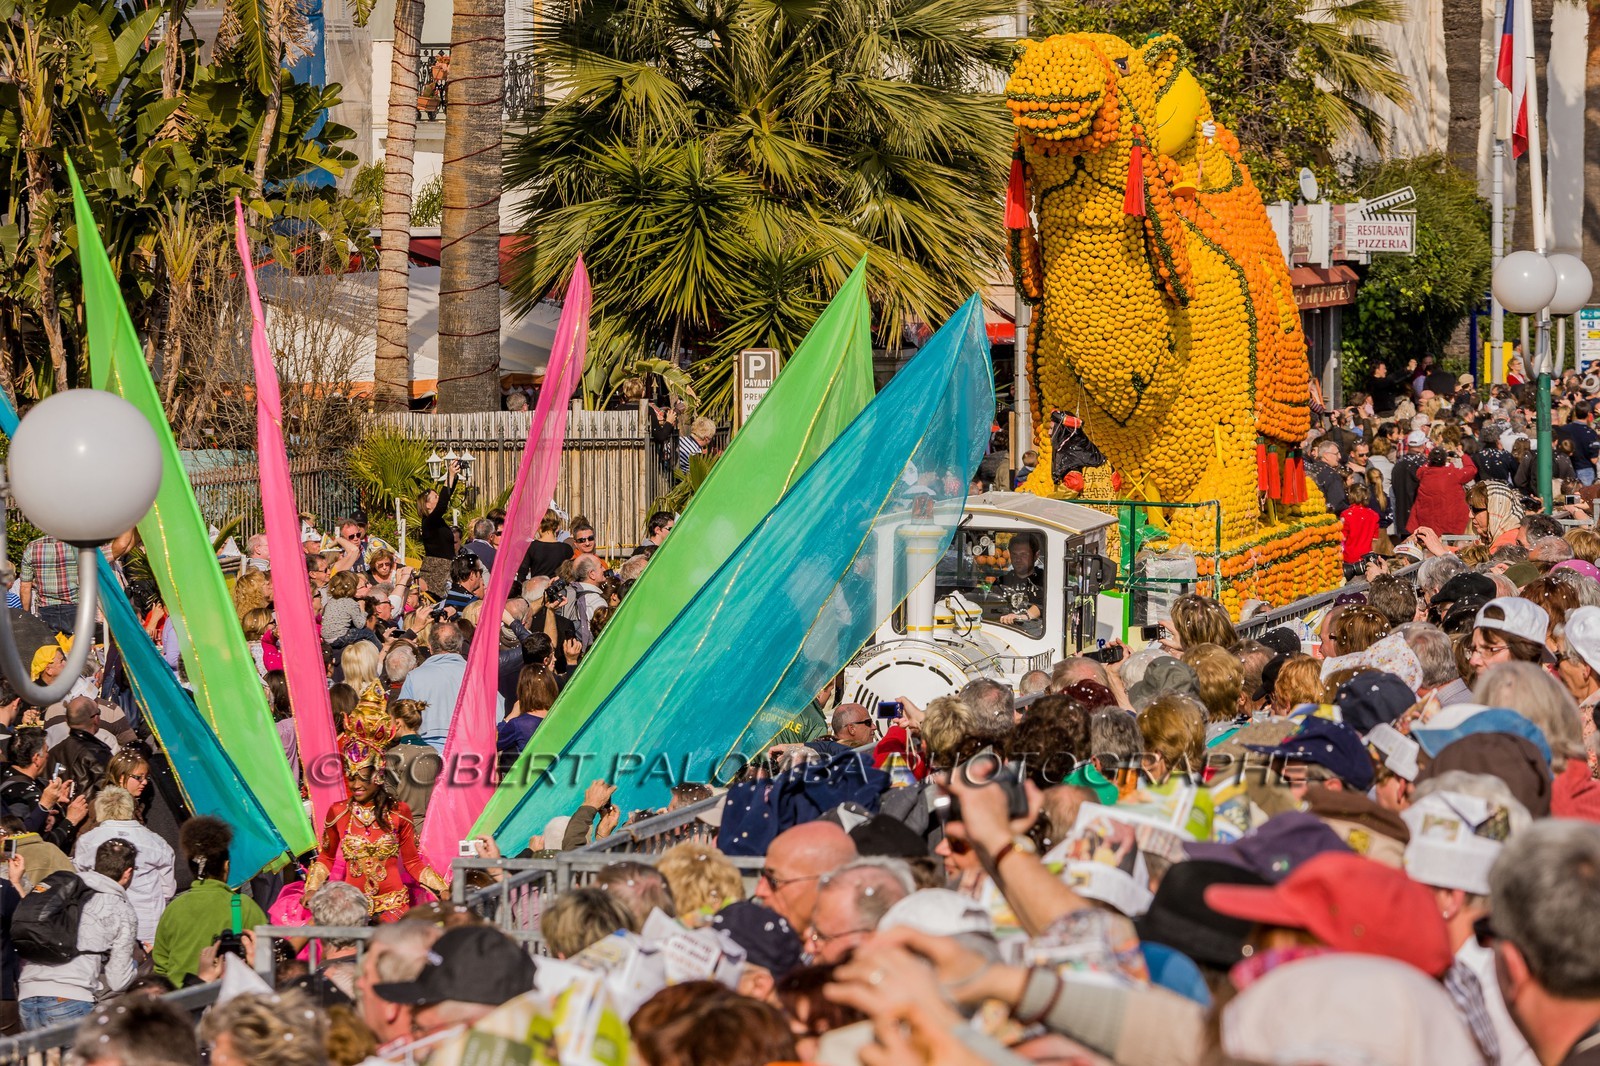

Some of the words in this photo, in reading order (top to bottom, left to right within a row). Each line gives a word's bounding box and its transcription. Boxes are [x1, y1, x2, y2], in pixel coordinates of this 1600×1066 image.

[1357, 225, 1410, 237] RESTAURANT
[1357, 239, 1408, 249] PIZZERIA
[749, 356, 766, 378] P
[744, 379, 770, 387] PAYANT
